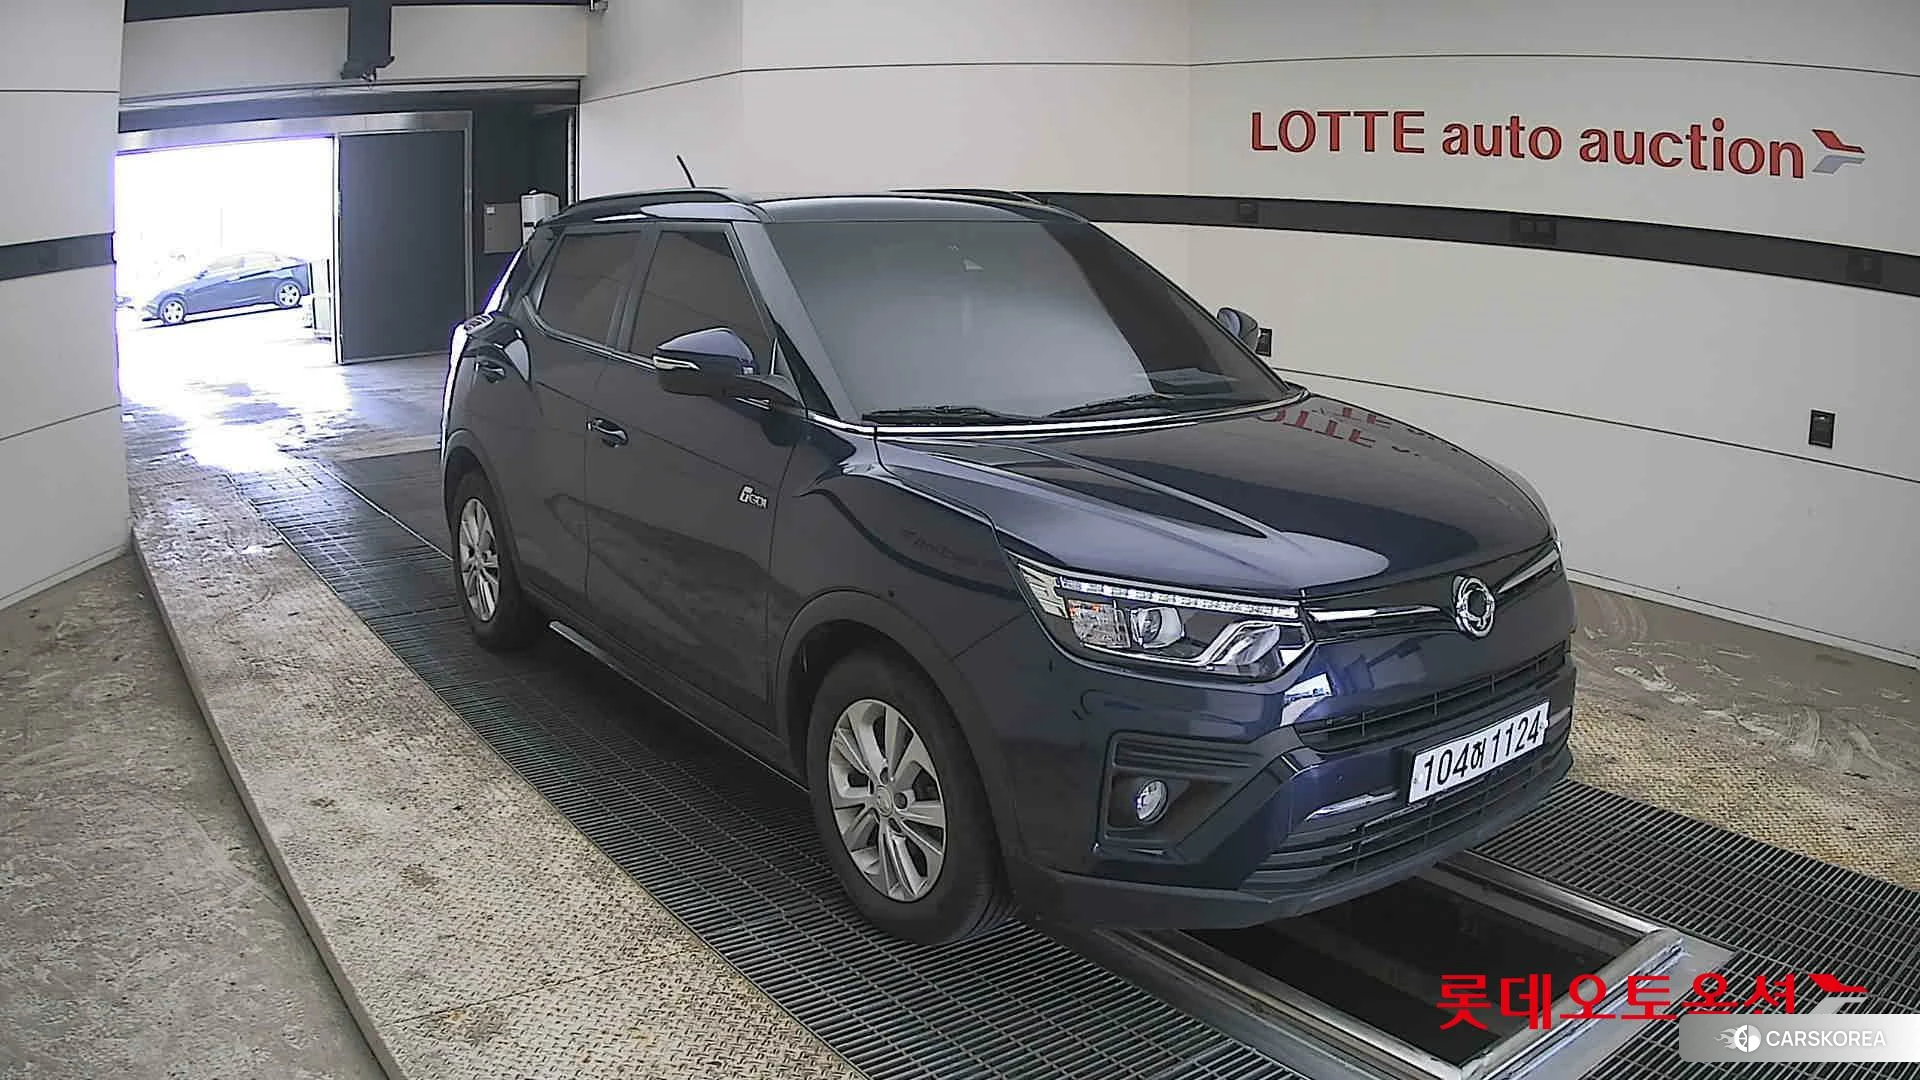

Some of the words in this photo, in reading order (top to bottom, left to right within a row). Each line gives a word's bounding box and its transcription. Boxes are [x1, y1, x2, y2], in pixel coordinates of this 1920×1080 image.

[1251, 110, 1425, 154] LOTTE
[1441, 115, 1562, 160] auto
[1579, 118, 1804, 179] auction
